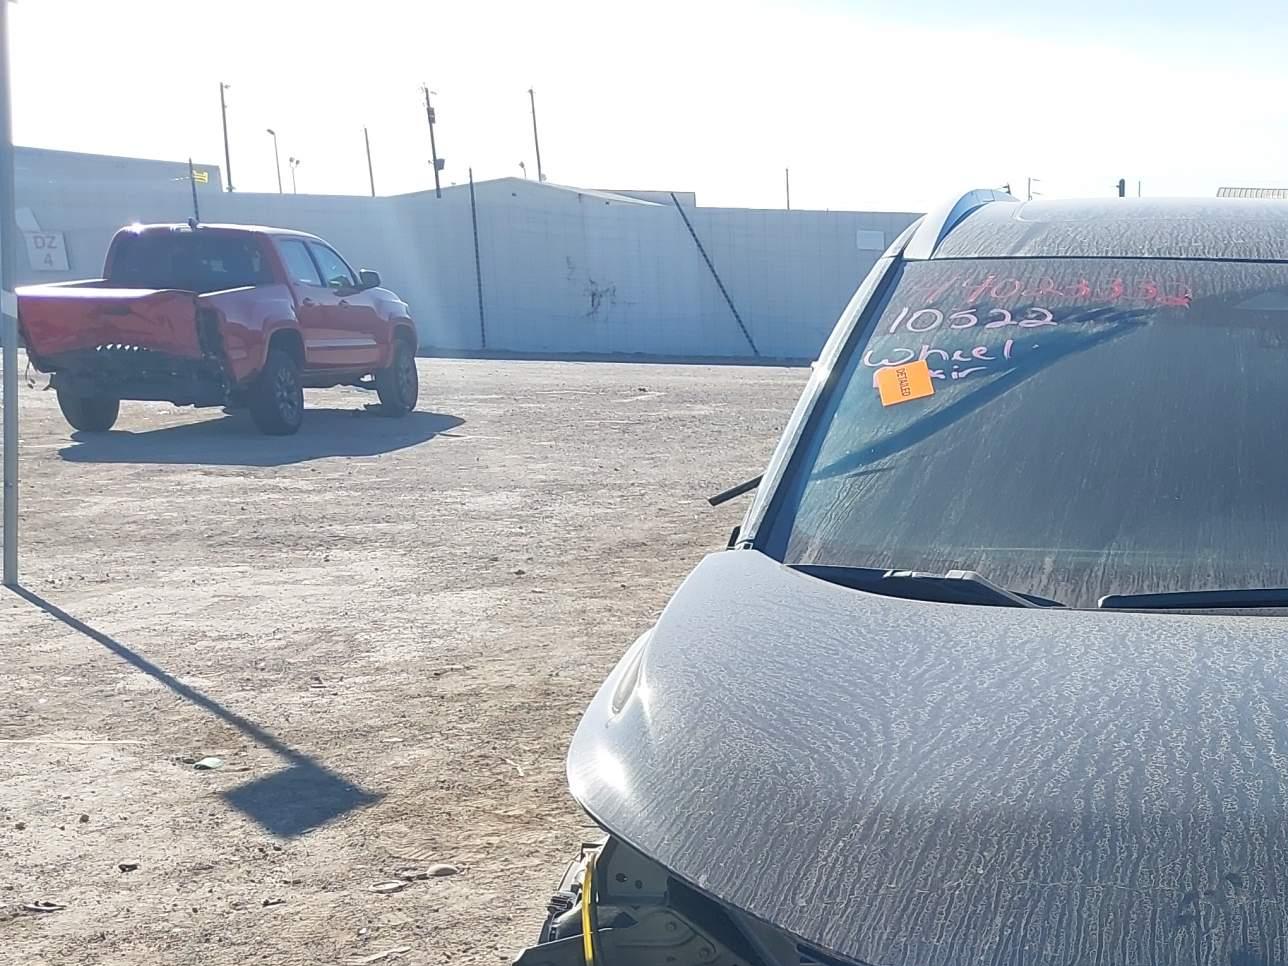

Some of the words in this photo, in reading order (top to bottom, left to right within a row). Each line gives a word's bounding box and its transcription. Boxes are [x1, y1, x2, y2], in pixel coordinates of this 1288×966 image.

[33, 235, 57, 249] DZ
[889, 307, 1057, 333] 10522
[895, 367, 911, 397] DETAILED
